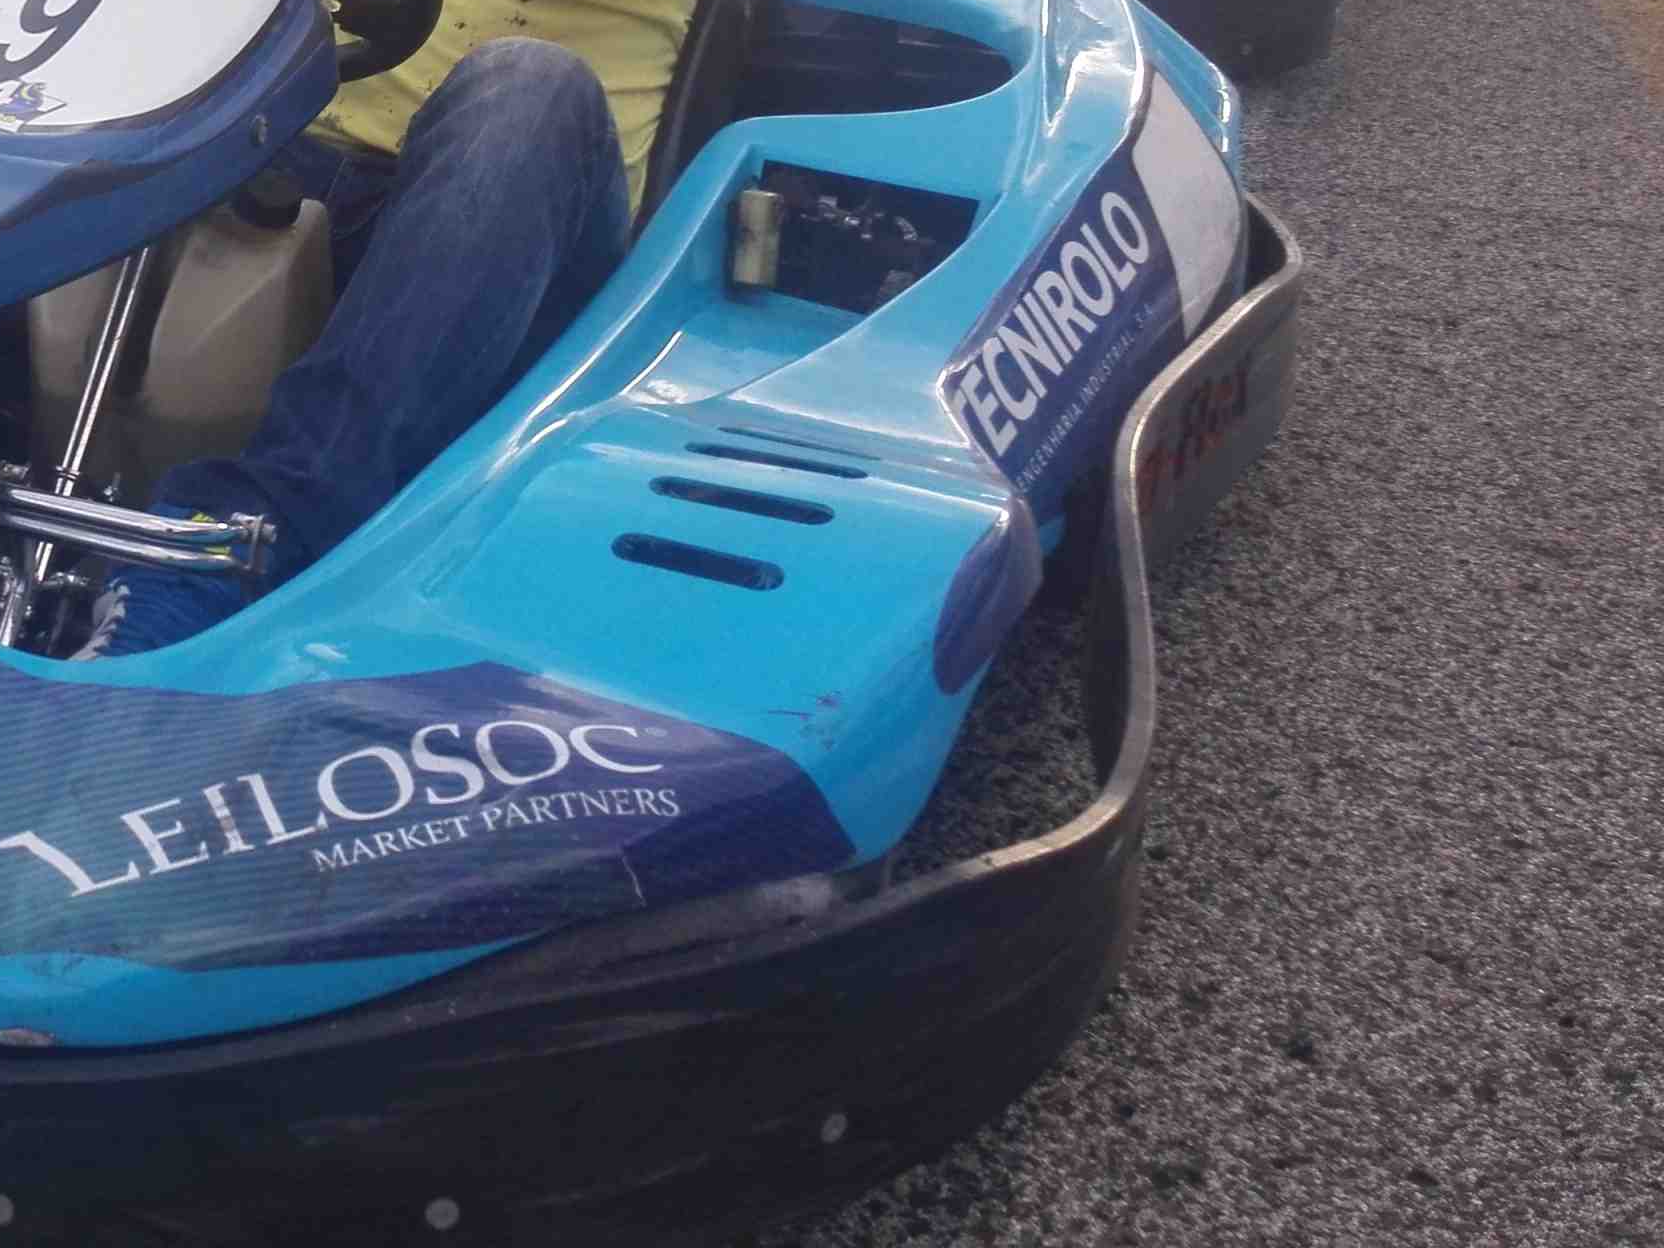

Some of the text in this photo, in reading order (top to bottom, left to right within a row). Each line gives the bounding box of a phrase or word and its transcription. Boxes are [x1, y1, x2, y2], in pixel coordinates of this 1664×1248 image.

[953, 191, 1150, 456] TECNIROLO
[311, 787, 681, 874] MARKET PARTNERS
